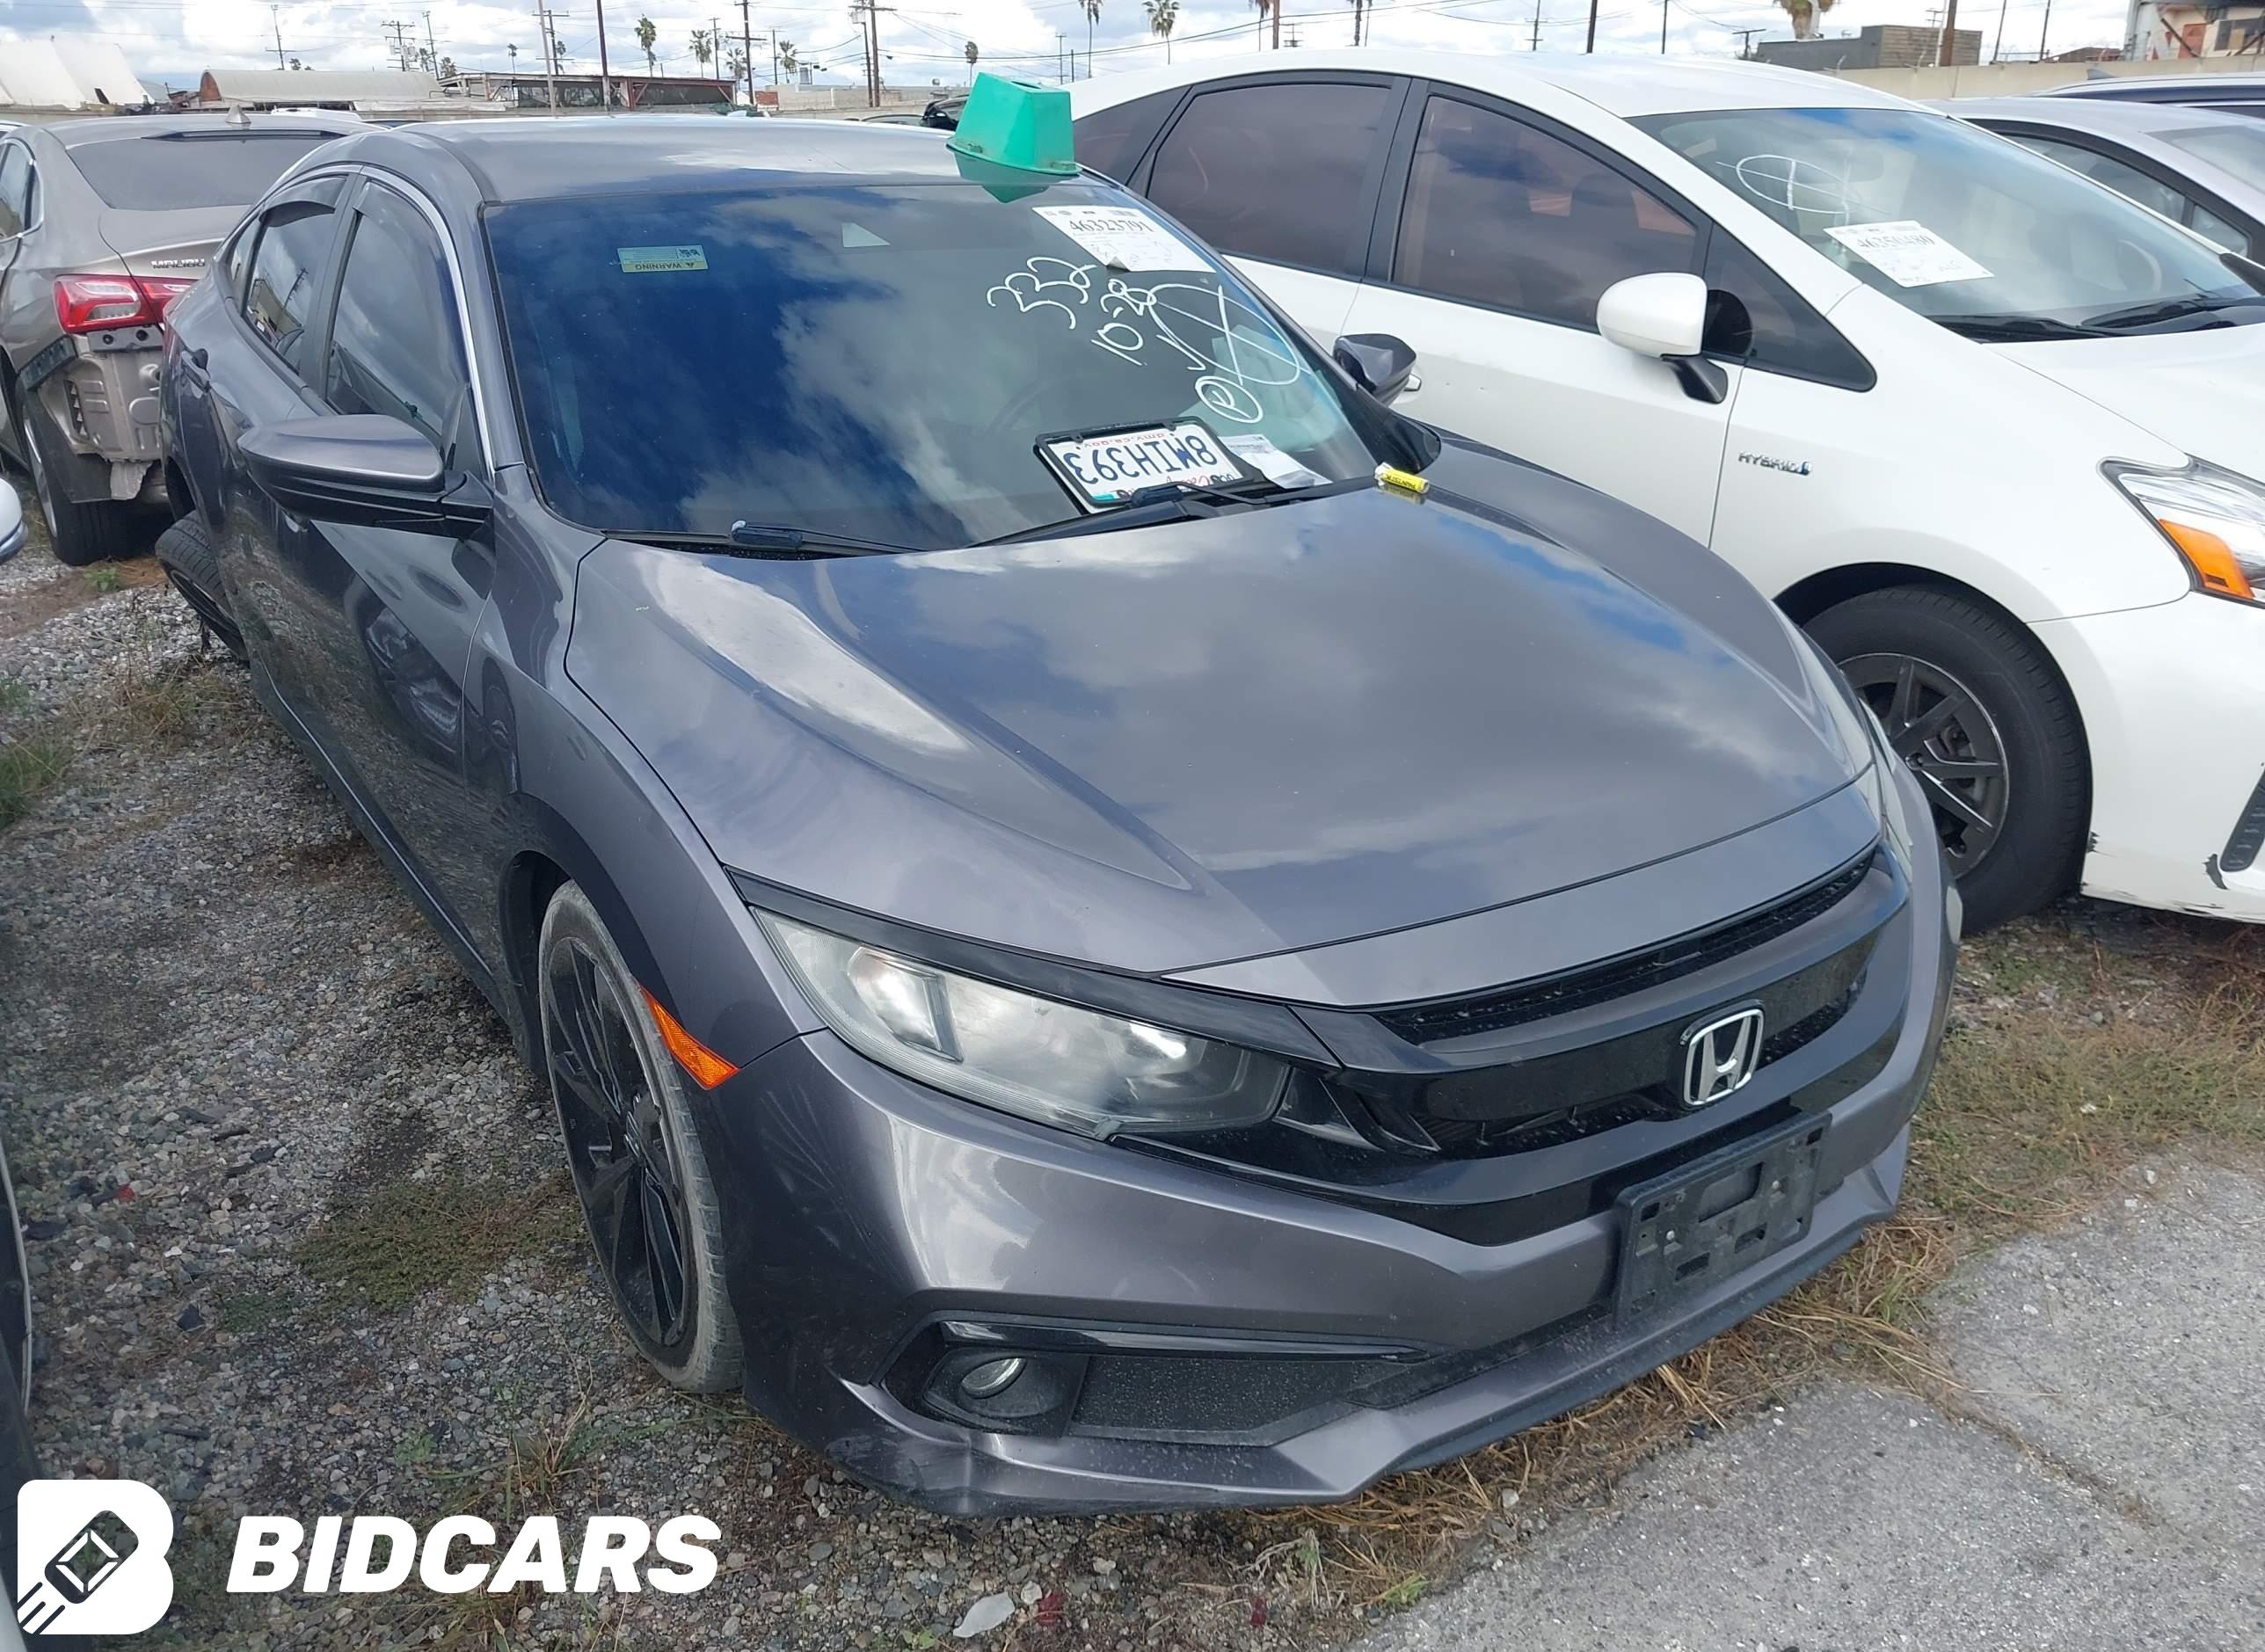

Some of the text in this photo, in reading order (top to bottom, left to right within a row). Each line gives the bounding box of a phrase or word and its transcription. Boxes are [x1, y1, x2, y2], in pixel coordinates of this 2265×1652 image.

[1068, 219, 1154, 233] 46323791
[150, 258, 206, 269] MALIBU
[1082, 432, 1166, 449] dmv.ca.gov
[1062, 434, 1219, 485] 8MIH393
[1737, 451, 1801, 473] HYBRID
